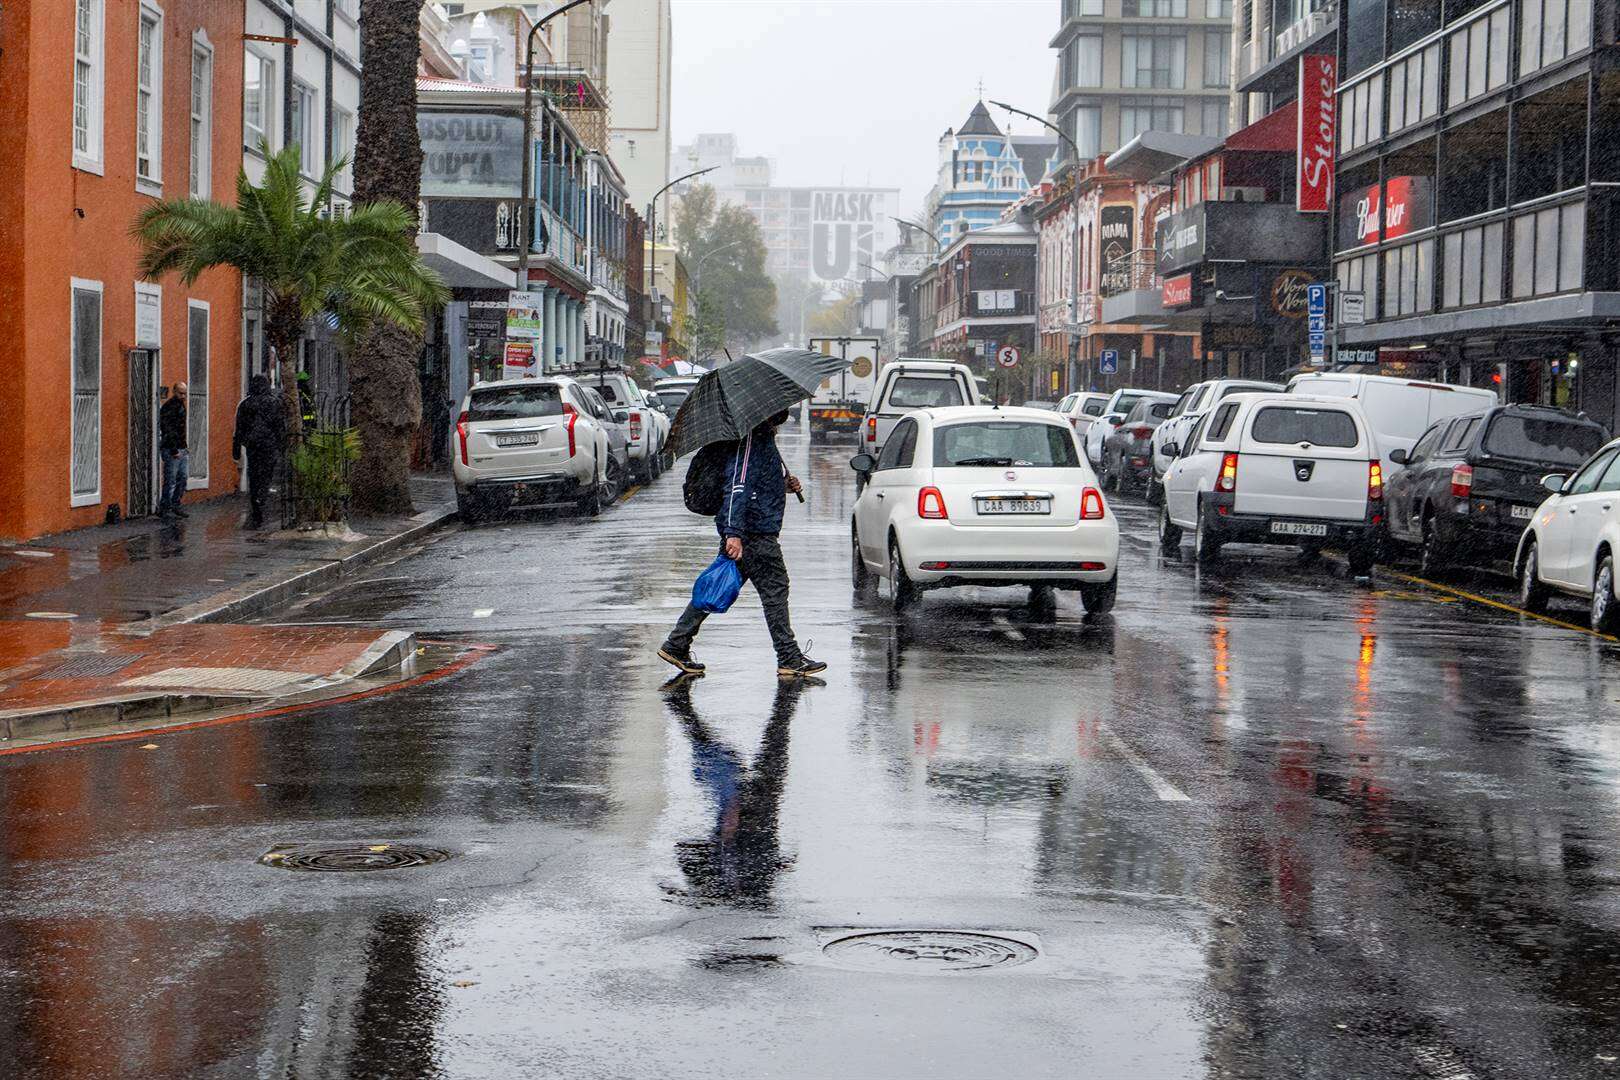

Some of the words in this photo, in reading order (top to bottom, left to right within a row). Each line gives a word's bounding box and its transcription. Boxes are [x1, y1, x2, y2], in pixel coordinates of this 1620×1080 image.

[420, 119, 503, 141] BSOLUT
[1304, 60, 1333, 205] Stones
[424, 152, 494, 176] ODKA
[814, 192, 874, 221] MASK
[1102, 222, 1128, 239] MAMA
[975, 247, 1004, 257] GOOD
[1007, 247, 1033, 257] TIMES
[1312, 288, 1321, 302] P
[1104, 351, 1114, 362] P
[984, 501, 1004, 512] CAA
[1010, 501, 1041, 512] 89839
[1273, 522, 1288, 533] CAA
